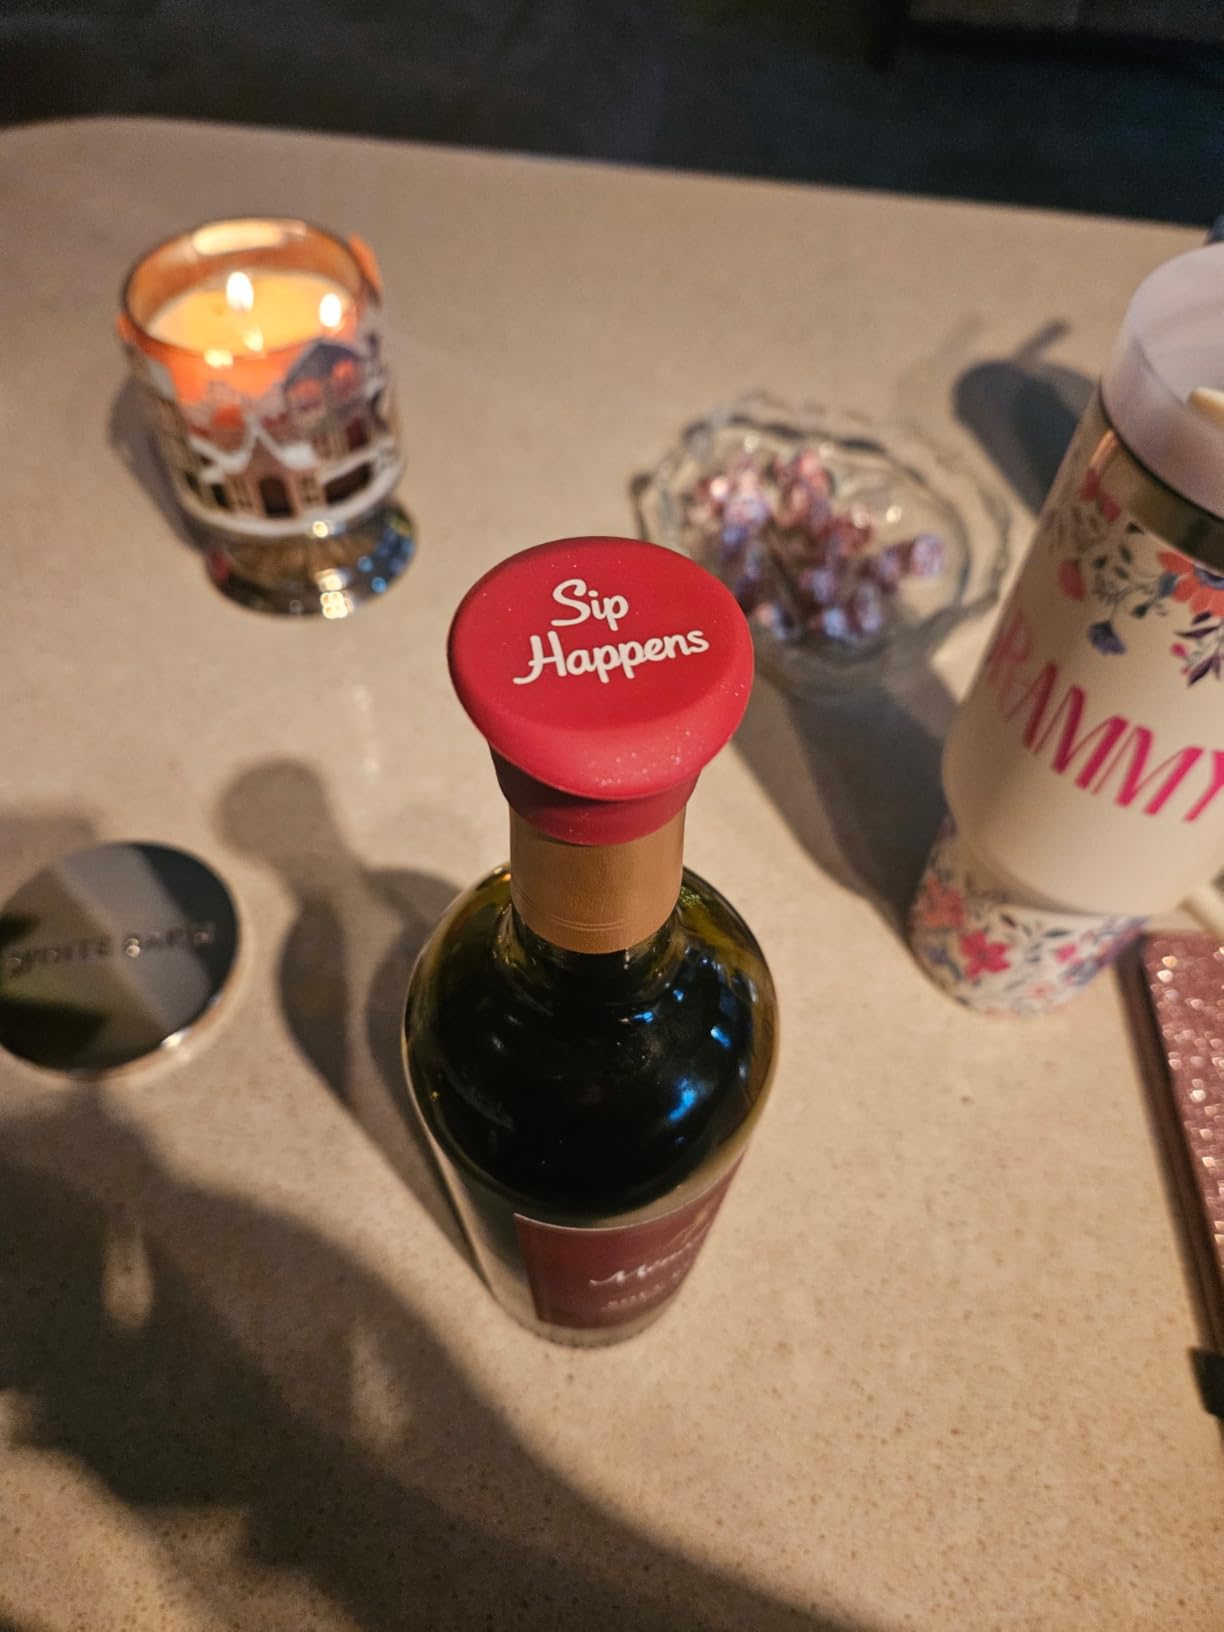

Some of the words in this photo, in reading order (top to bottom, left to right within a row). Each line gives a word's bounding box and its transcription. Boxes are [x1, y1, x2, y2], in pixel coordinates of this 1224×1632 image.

[551, 578, 629, 631] Sip
[512, 630, 710, 684] Happens
[983, 608, 1224, 823] RAMMY
